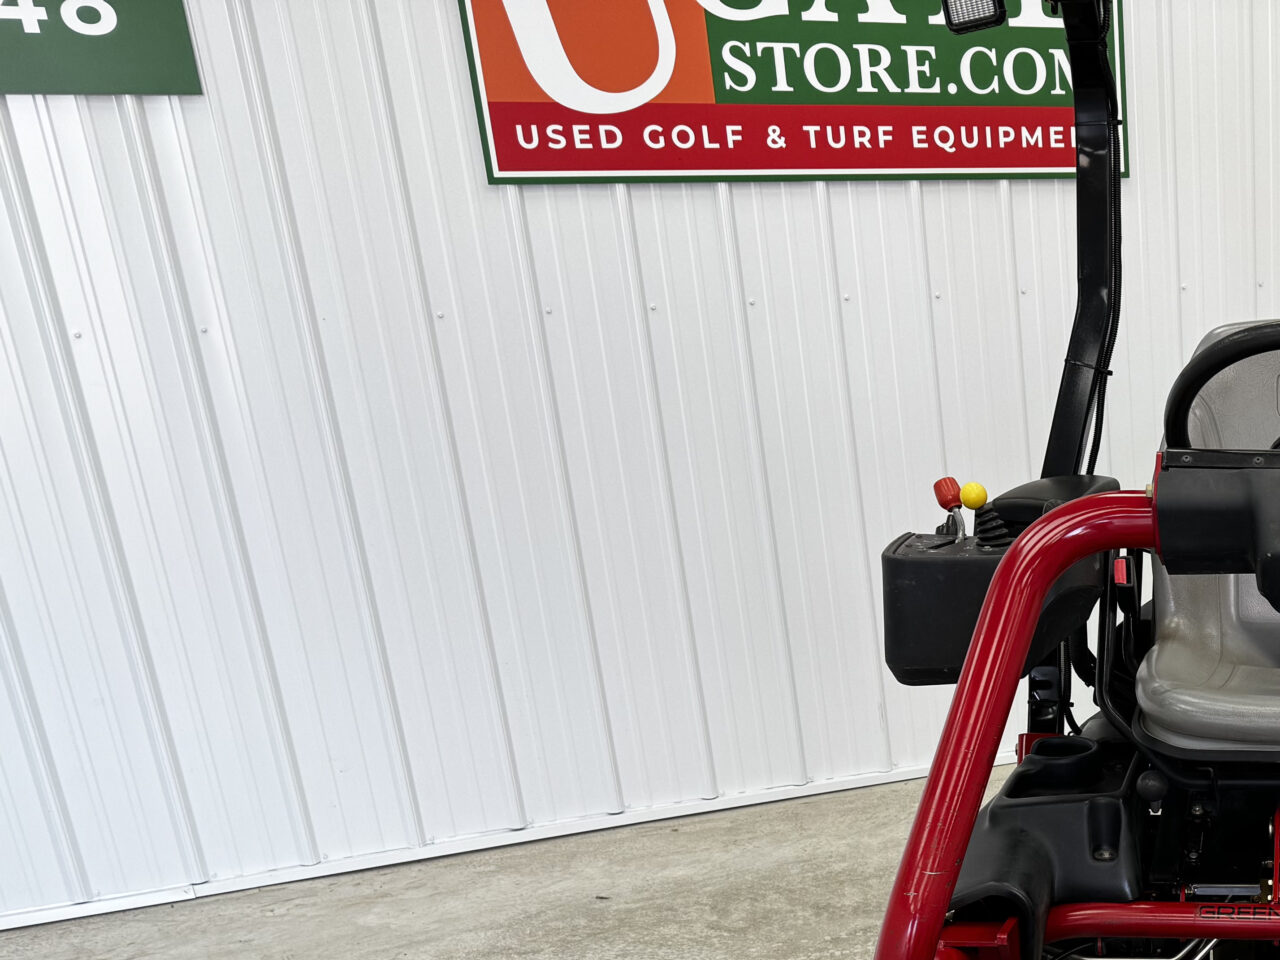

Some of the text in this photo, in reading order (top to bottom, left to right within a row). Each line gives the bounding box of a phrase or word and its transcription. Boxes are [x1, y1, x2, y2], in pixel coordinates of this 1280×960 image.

[515, 124, 1076, 153] USED GOLF & TURF EQUIPME
